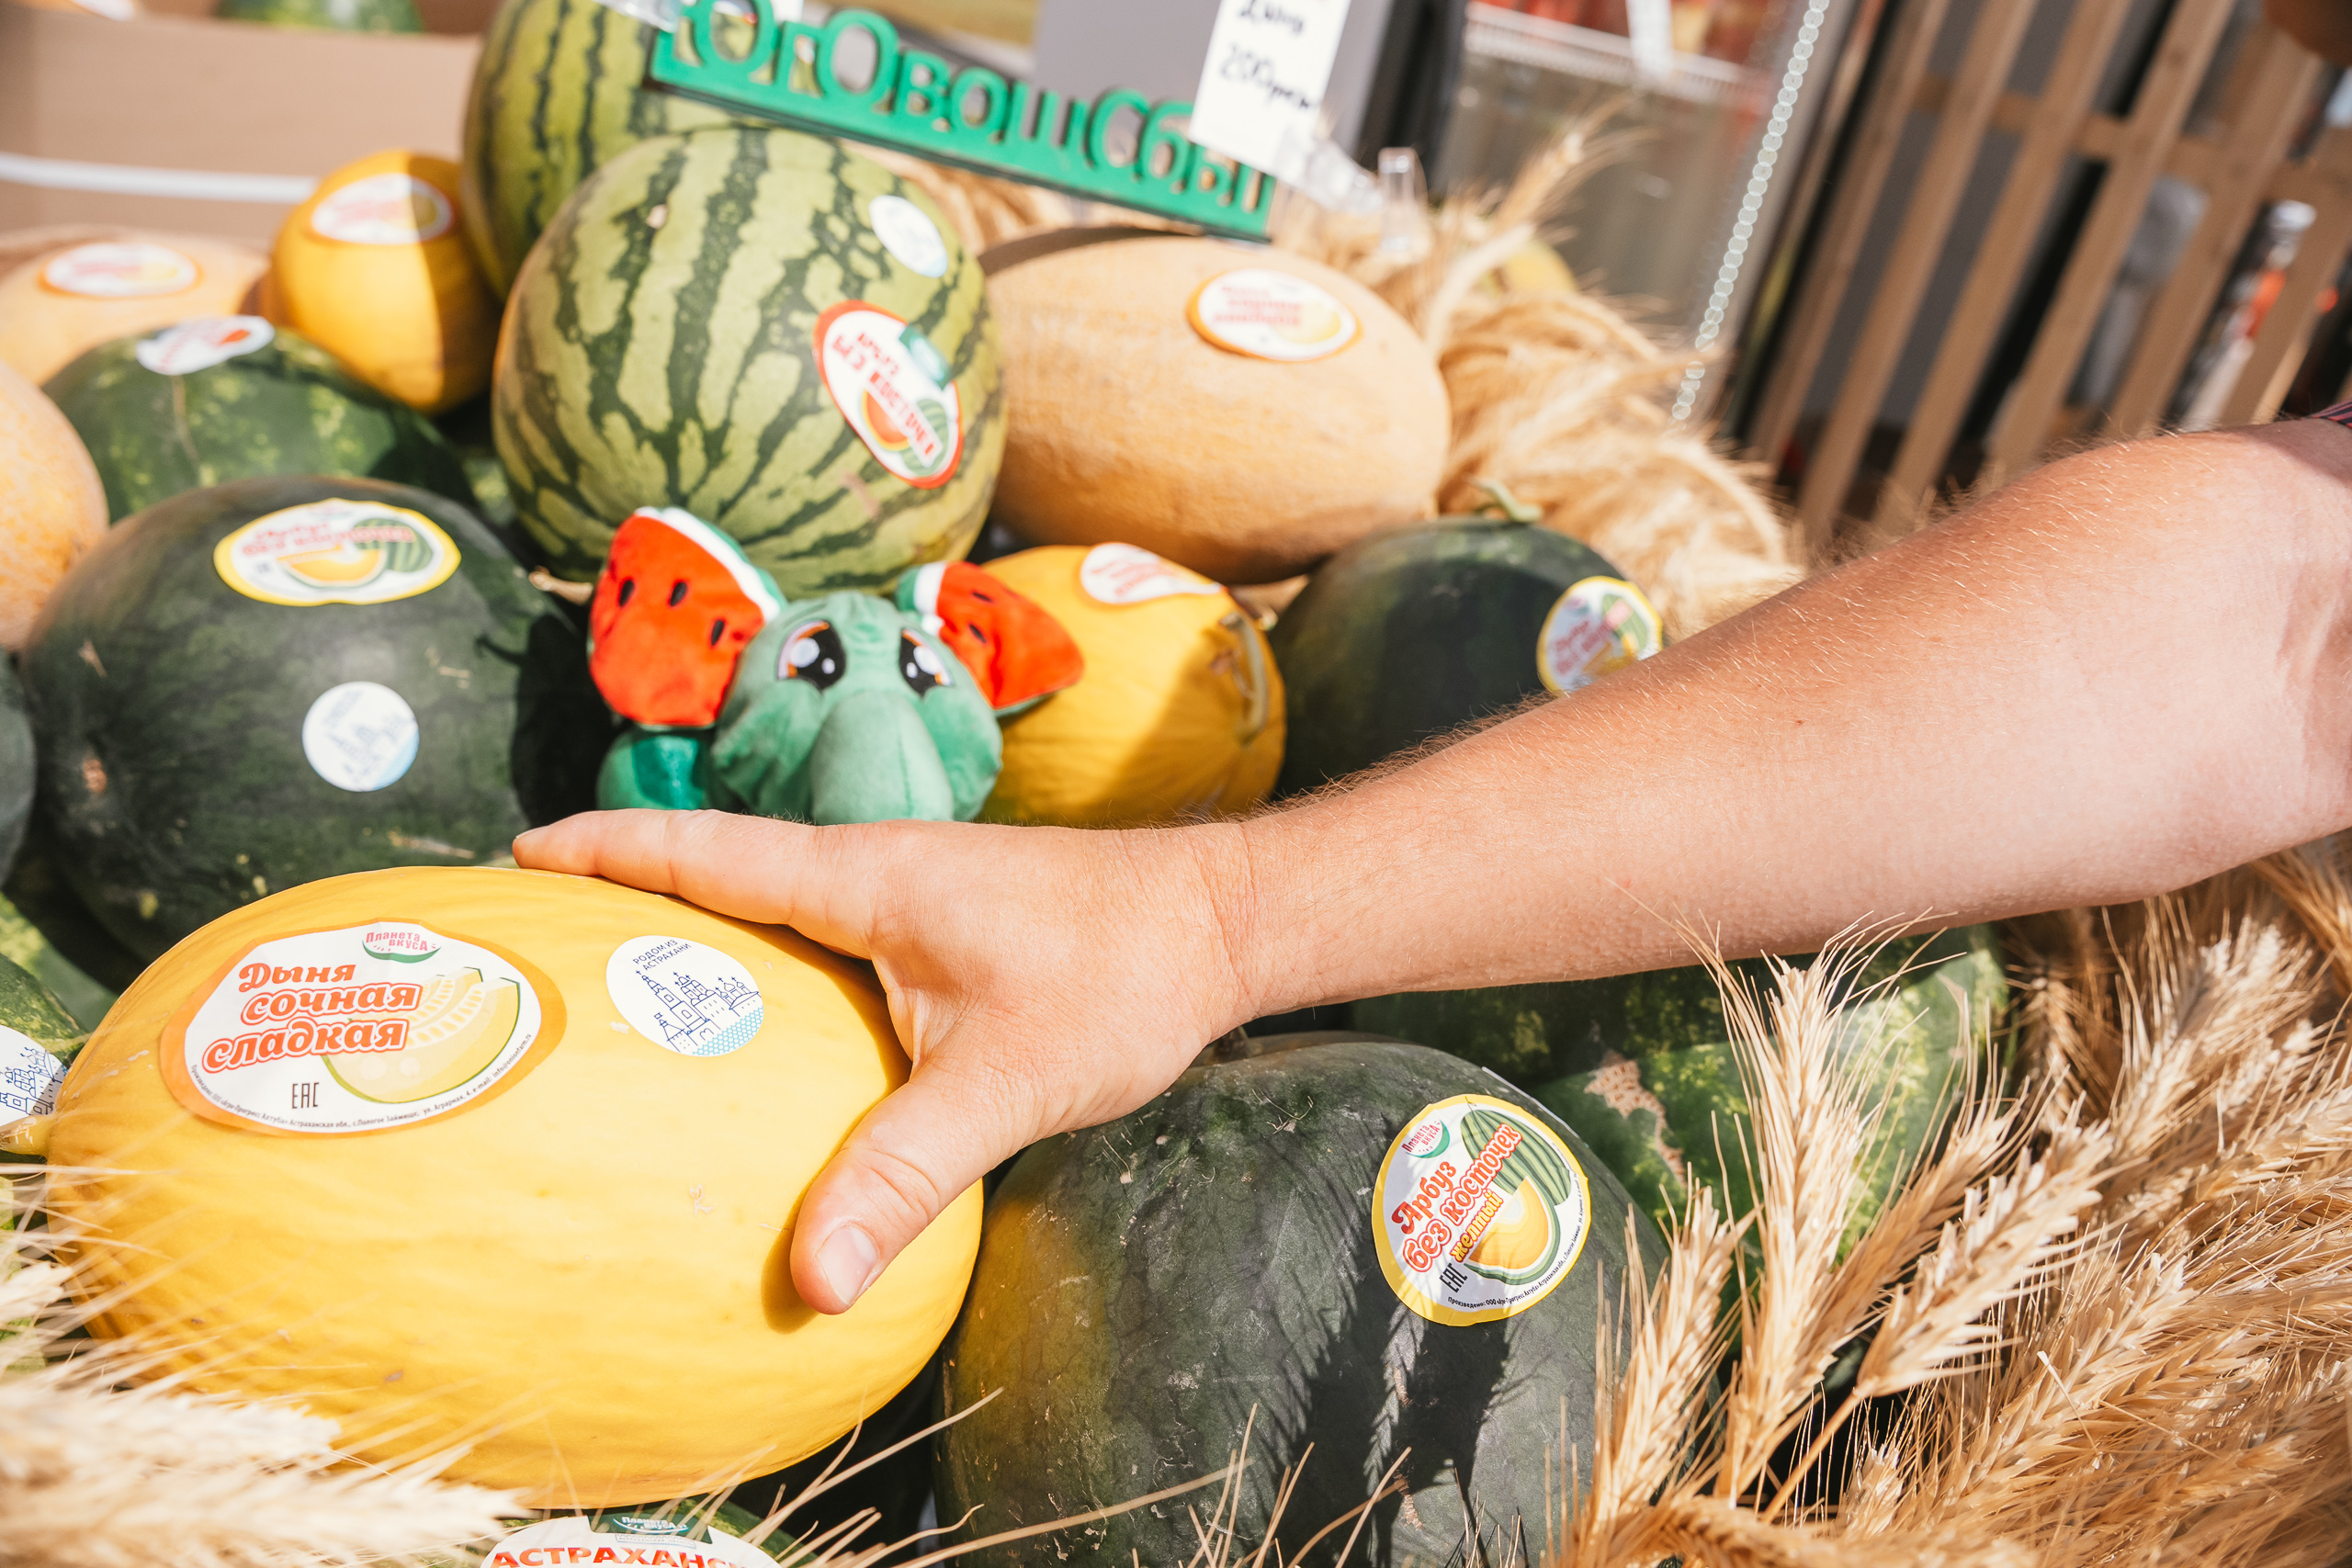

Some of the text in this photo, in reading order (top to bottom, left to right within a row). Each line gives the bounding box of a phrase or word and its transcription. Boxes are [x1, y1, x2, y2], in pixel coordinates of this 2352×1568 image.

[650, 0, 1275, 220] ЮгОвощСбы
[366, 931, 421, 943] Планета
[632, 939, 678, 964] РОДОМ ИЗ
[642, 942, 692, 971] АСТРАХАНИ
[238, 962, 356, 993] Дыня
[242, 983, 422, 1024] сочная
[203, 1017, 409, 1073] сладкая
[1391, 1161, 1457, 1235] Арбуз
[1403, 1123, 1522, 1272] без косточек
[1449, 1189, 1503, 1262] желтый
[490, 1546, 748, 1568] АСТРАХАНС
